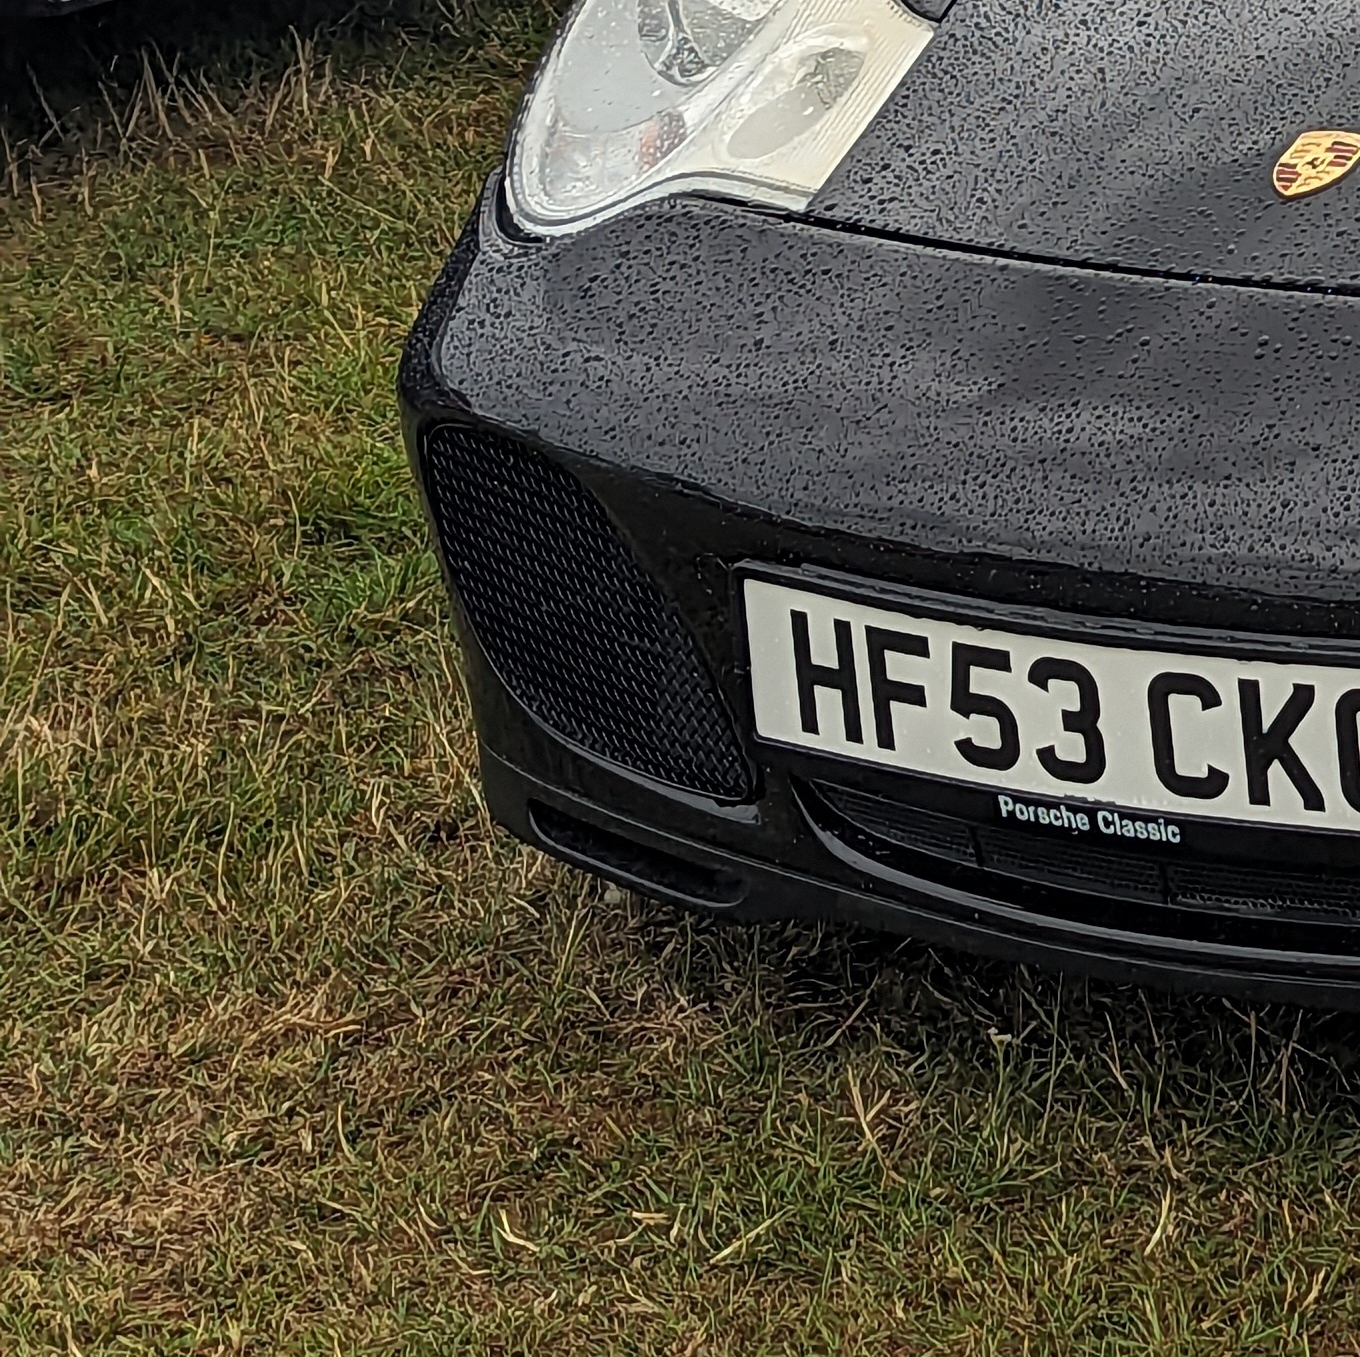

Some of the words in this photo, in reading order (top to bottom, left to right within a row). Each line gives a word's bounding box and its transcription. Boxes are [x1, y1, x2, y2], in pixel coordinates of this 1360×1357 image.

[791, 608, 1107, 785] HF53
[998, 794, 1090, 831] Porsche
[1097, 810, 1181, 844] Classic
